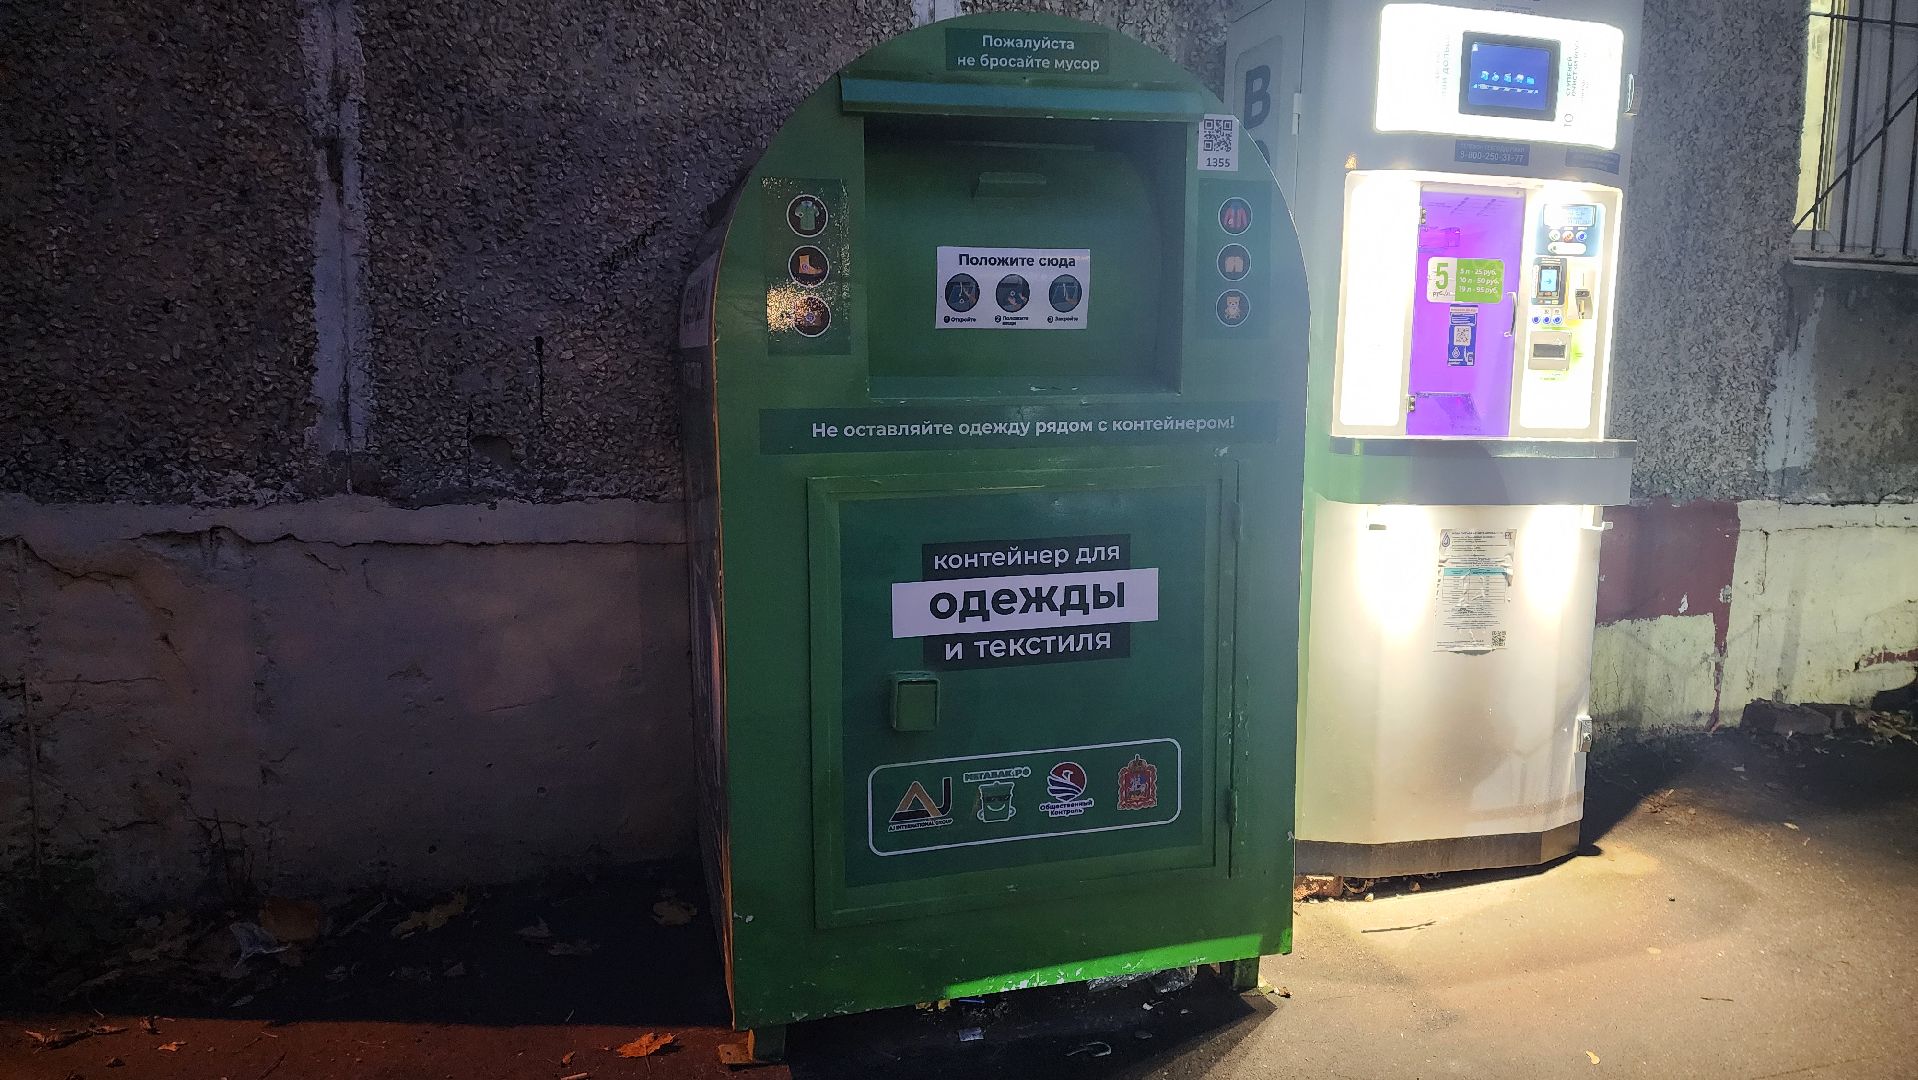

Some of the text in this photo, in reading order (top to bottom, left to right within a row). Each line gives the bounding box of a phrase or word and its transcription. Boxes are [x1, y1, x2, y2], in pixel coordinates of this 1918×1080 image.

[981, 34, 1075, 51] Пожалуйста
[957, 53, 1100, 72] не бросайте мусор
[1205, 157, 1231, 168] 1355
[958, 253, 1076, 268] Положите сюда
[1435, 262, 1449, 290] 5
[811, 415, 1236, 438] Не оставляйте одежду рядом с контейнером!
[934, 545, 1120, 570] контейнер для
[929, 582, 1125, 623] одежды
[945, 632, 1112, 661] и текстиля
[1040, 800, 1093, 812] Общественный
[1050, 808, 1083, 817] Контроль
